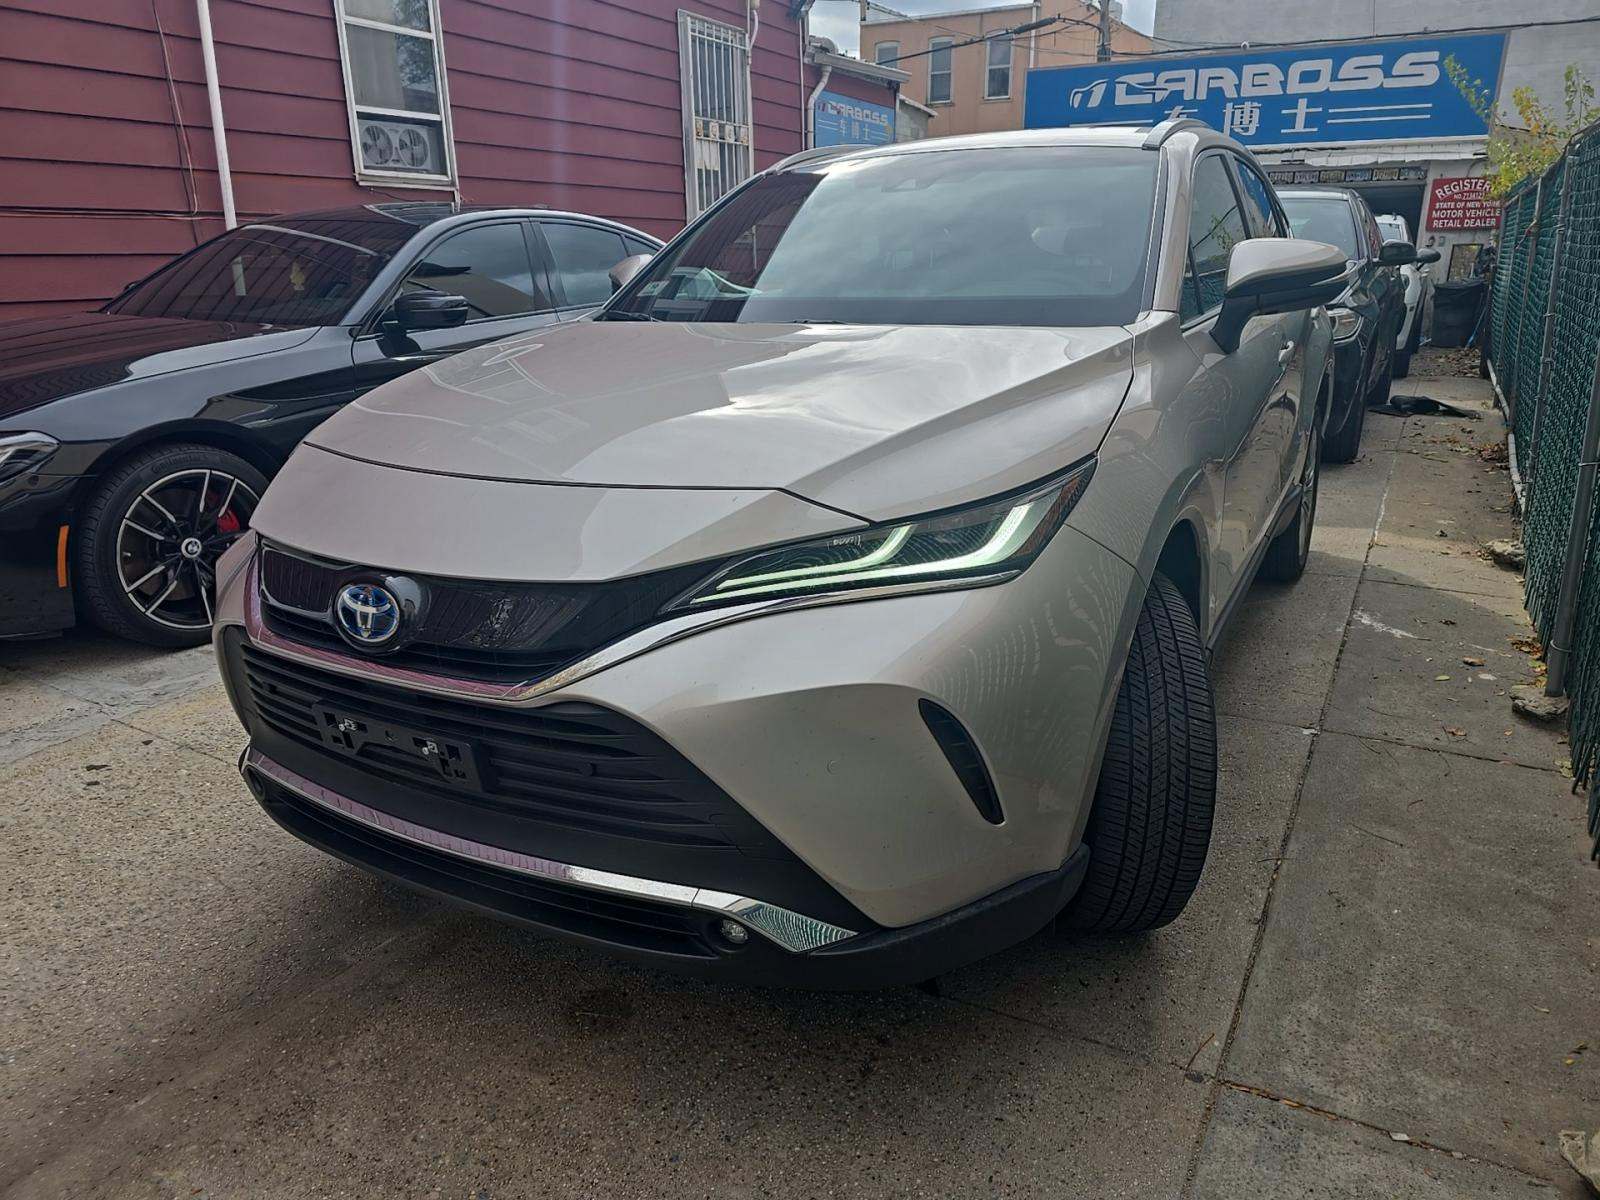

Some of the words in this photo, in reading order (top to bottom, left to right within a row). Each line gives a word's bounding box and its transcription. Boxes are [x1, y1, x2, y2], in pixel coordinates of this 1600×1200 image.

[1115, 51, 1440, 106] CARBOSS
[828, 101, 888, 125] CARBOSS
[1435, 180, 1492, 199] REGISTER
[1435, 201, 1455, 209] STATE
[1432, 209, 1463, 218] MOTOR
[1465, 208, 1502, 217] VEHICLE
[1432, 219, 1461, 228] RETAIL
[1463, 218, 1496, 227] DEALER
